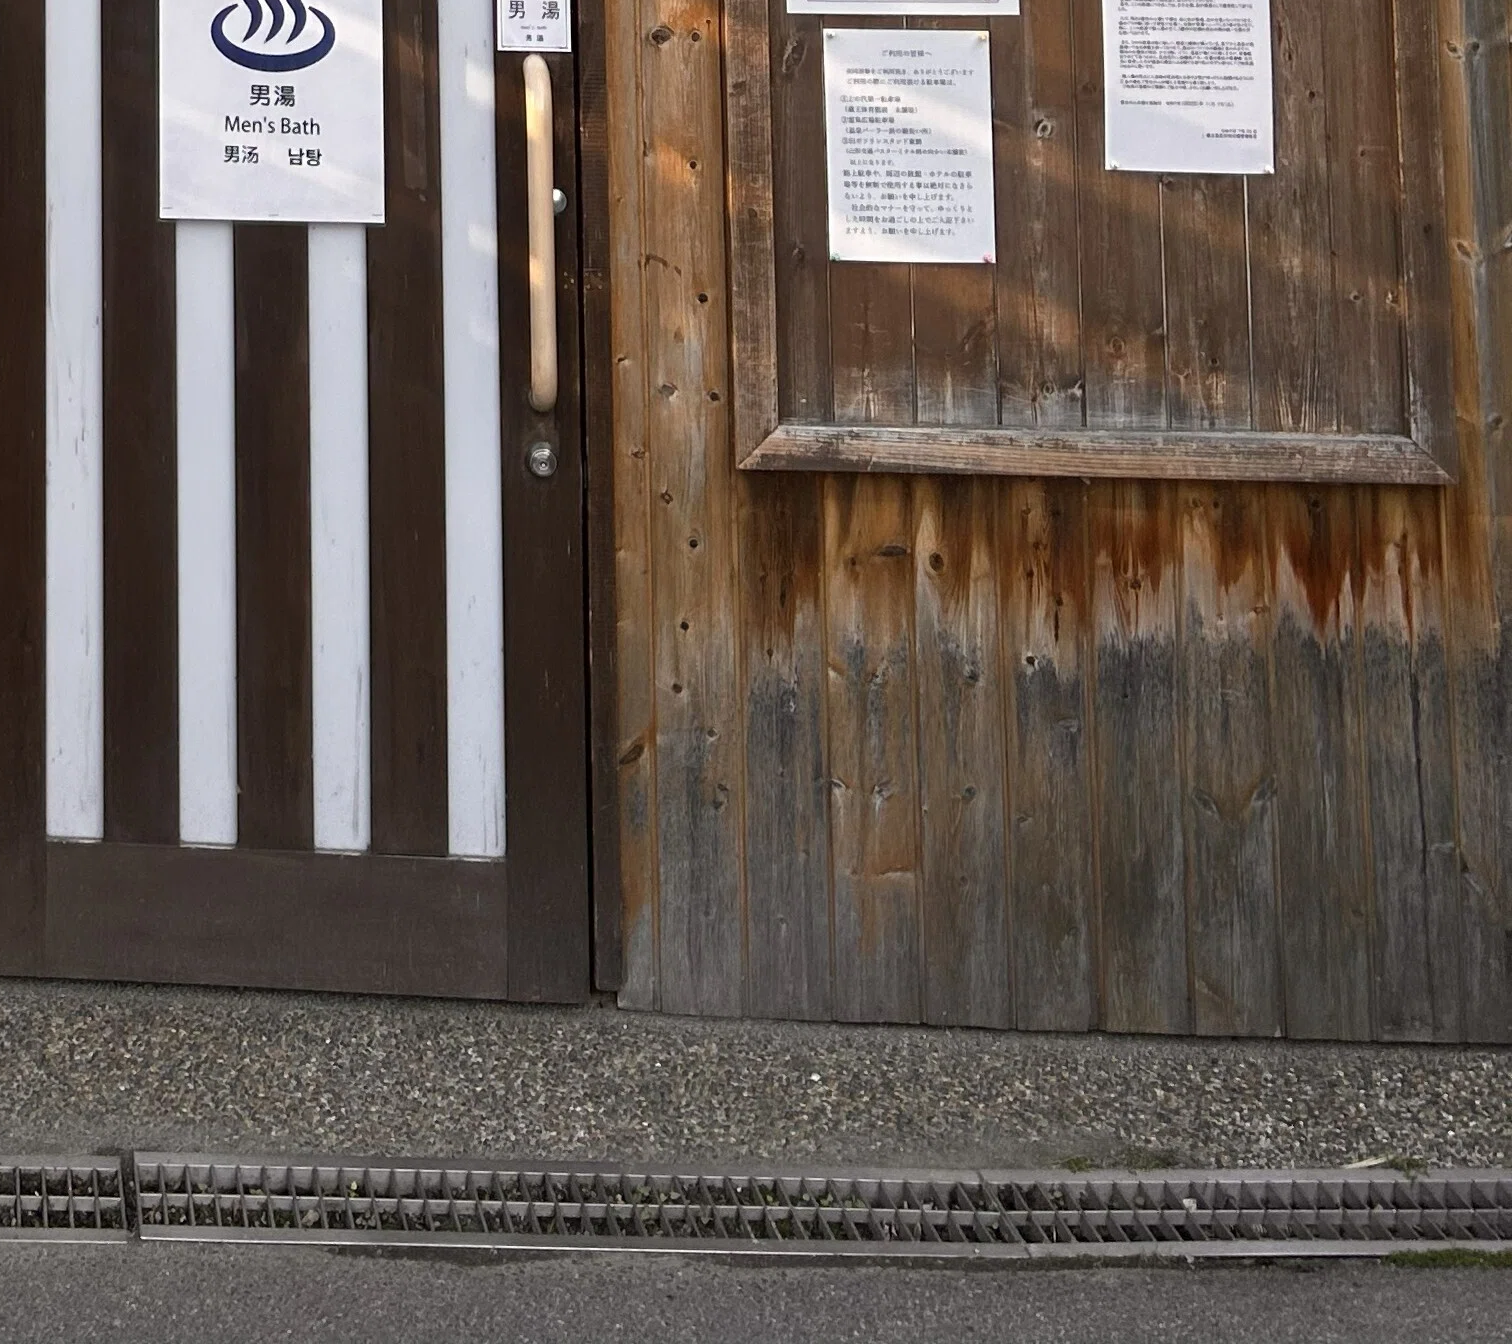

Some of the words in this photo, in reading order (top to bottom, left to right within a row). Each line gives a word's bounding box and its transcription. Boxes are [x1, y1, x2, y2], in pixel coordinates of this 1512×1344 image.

[508, 0, 561, 21] 男湯
[249, 84, 296, 107] 男湯
[224, 115, 276, 135] Men's
[280, 116, 321, 136] Bath
[223, 145, 259, 164] 男汤
[287, 146, 322, 167] 남탕
